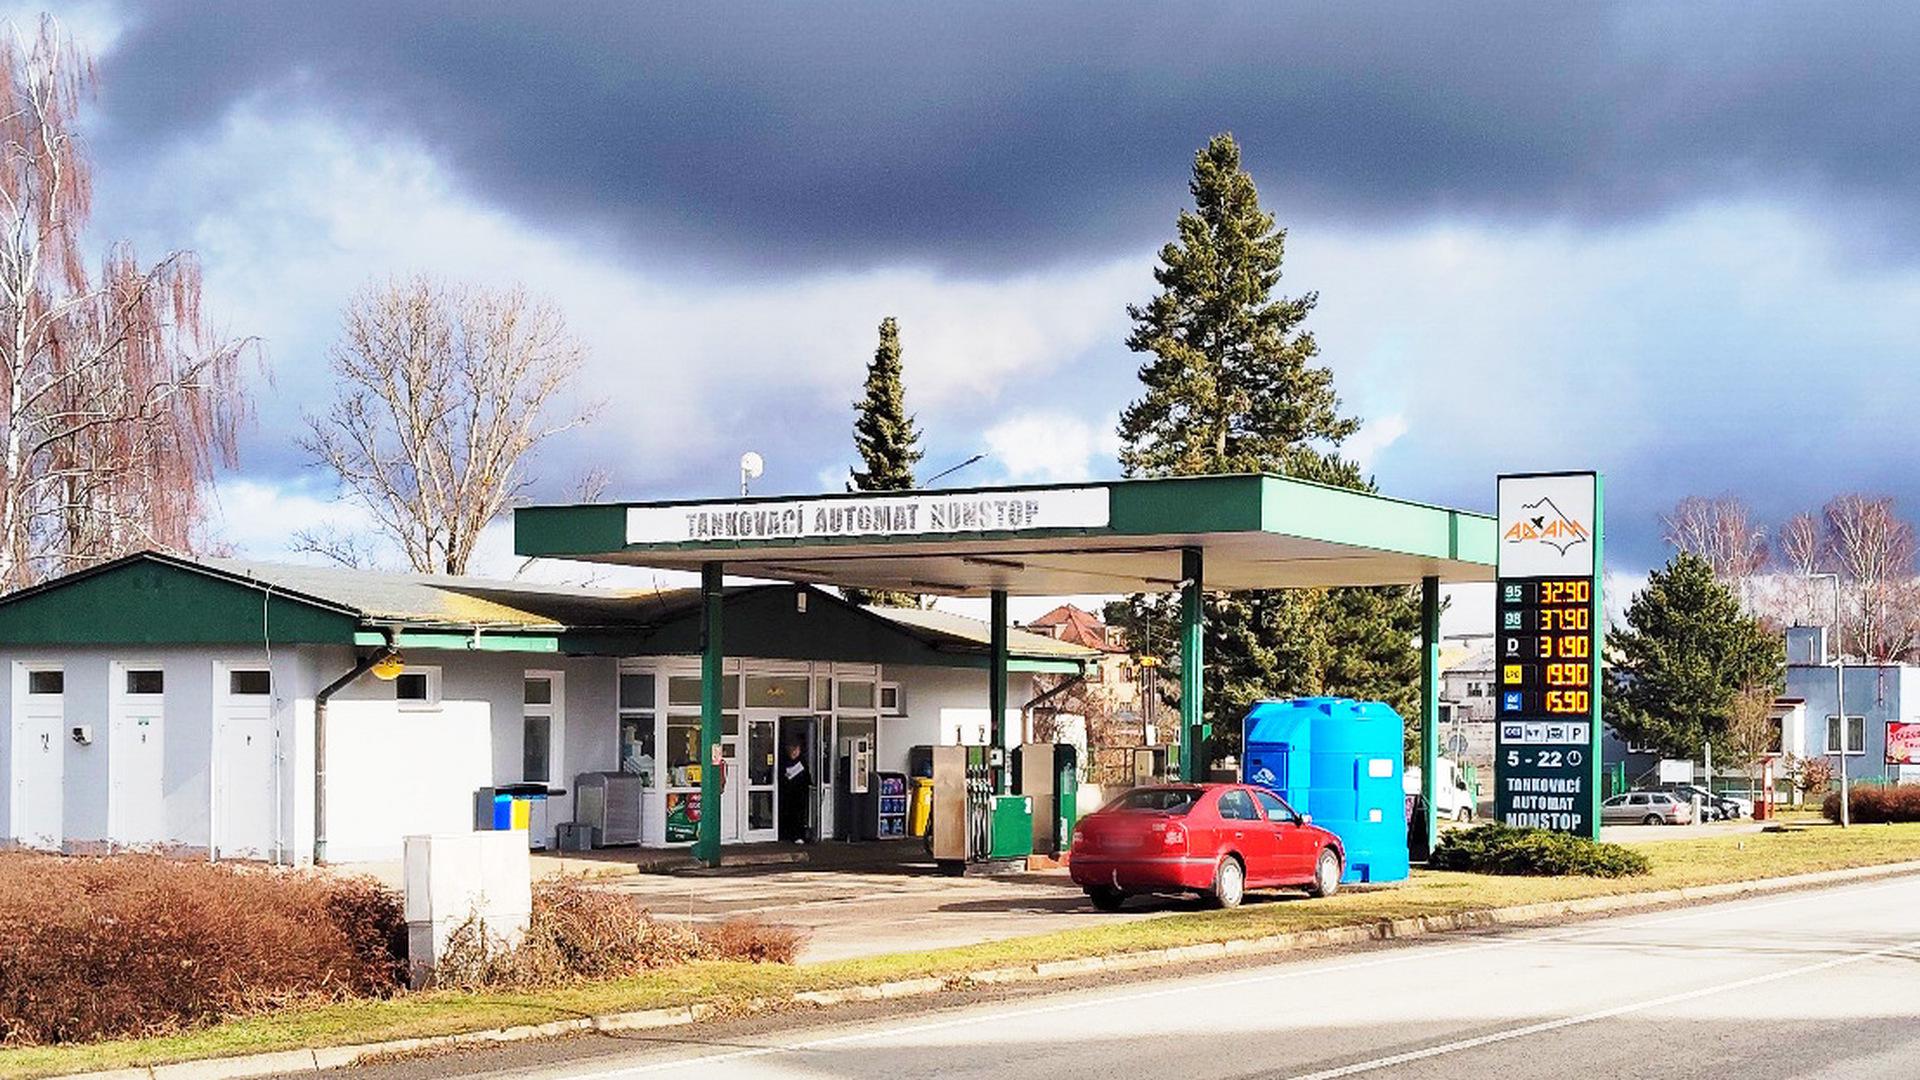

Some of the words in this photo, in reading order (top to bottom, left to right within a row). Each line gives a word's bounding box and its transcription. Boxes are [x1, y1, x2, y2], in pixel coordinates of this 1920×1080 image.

[686, 504, 803, 537] TANKOVACÍ
[814, 504, 919, 533] AUTOMAT
[930, 499, 1039, 530] NONSTOP
[1505, 585, 1523, 598] 95
[1541, 581, 1590, 604] 32.90
[1504, 612, 1522, 625] 98
[1507, 638, 1519, 653] D
[1507, 750, 1520, 767] 5
[1537, 750, 1563, 767] 22
[1506, 776, 1582, 793] TANKOVACÍ
[1512, 796, 1575, 811] AUTOMAT
[1505, 813, 1582, 830] NONSTOP
